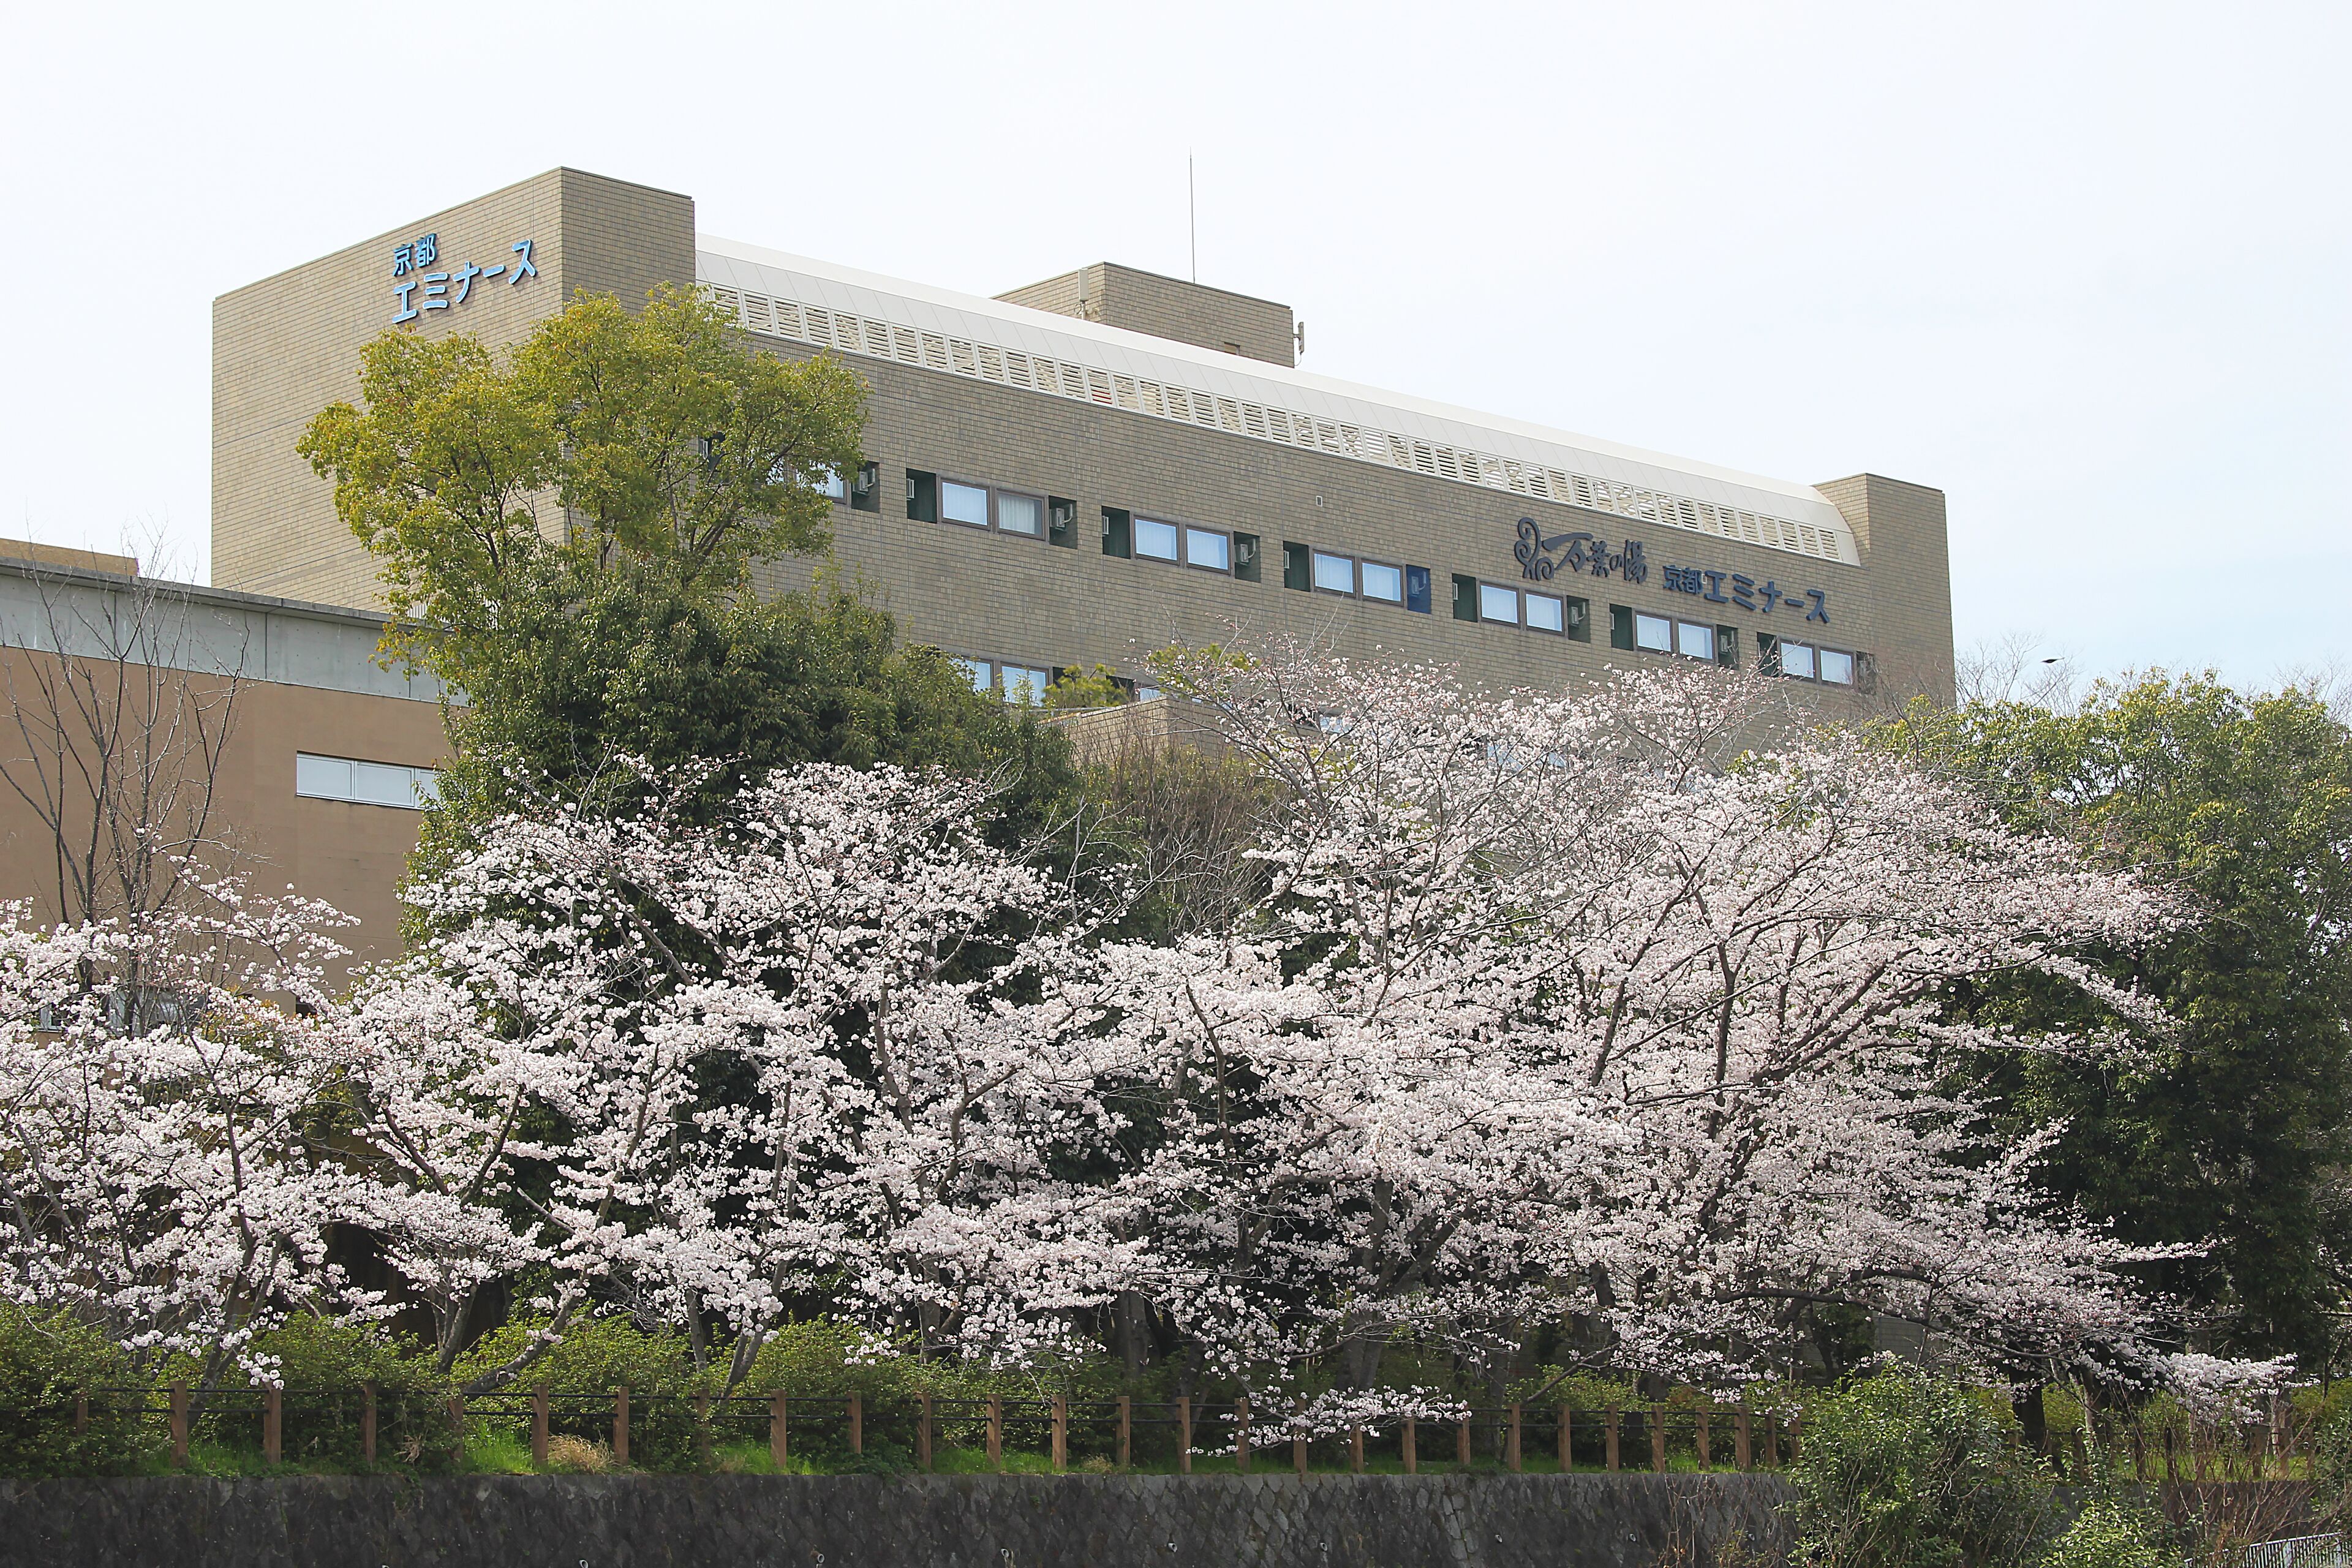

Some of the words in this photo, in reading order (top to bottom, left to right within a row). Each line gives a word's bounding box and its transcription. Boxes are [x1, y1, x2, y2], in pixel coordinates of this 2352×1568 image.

[392, 233, 437, 276] 京都
[392, 239, 537, 324] エミナース
[1541, 532, 1648, 584] 万葉の湯
[1662, 564, 1831, 624] 京都エミナース
